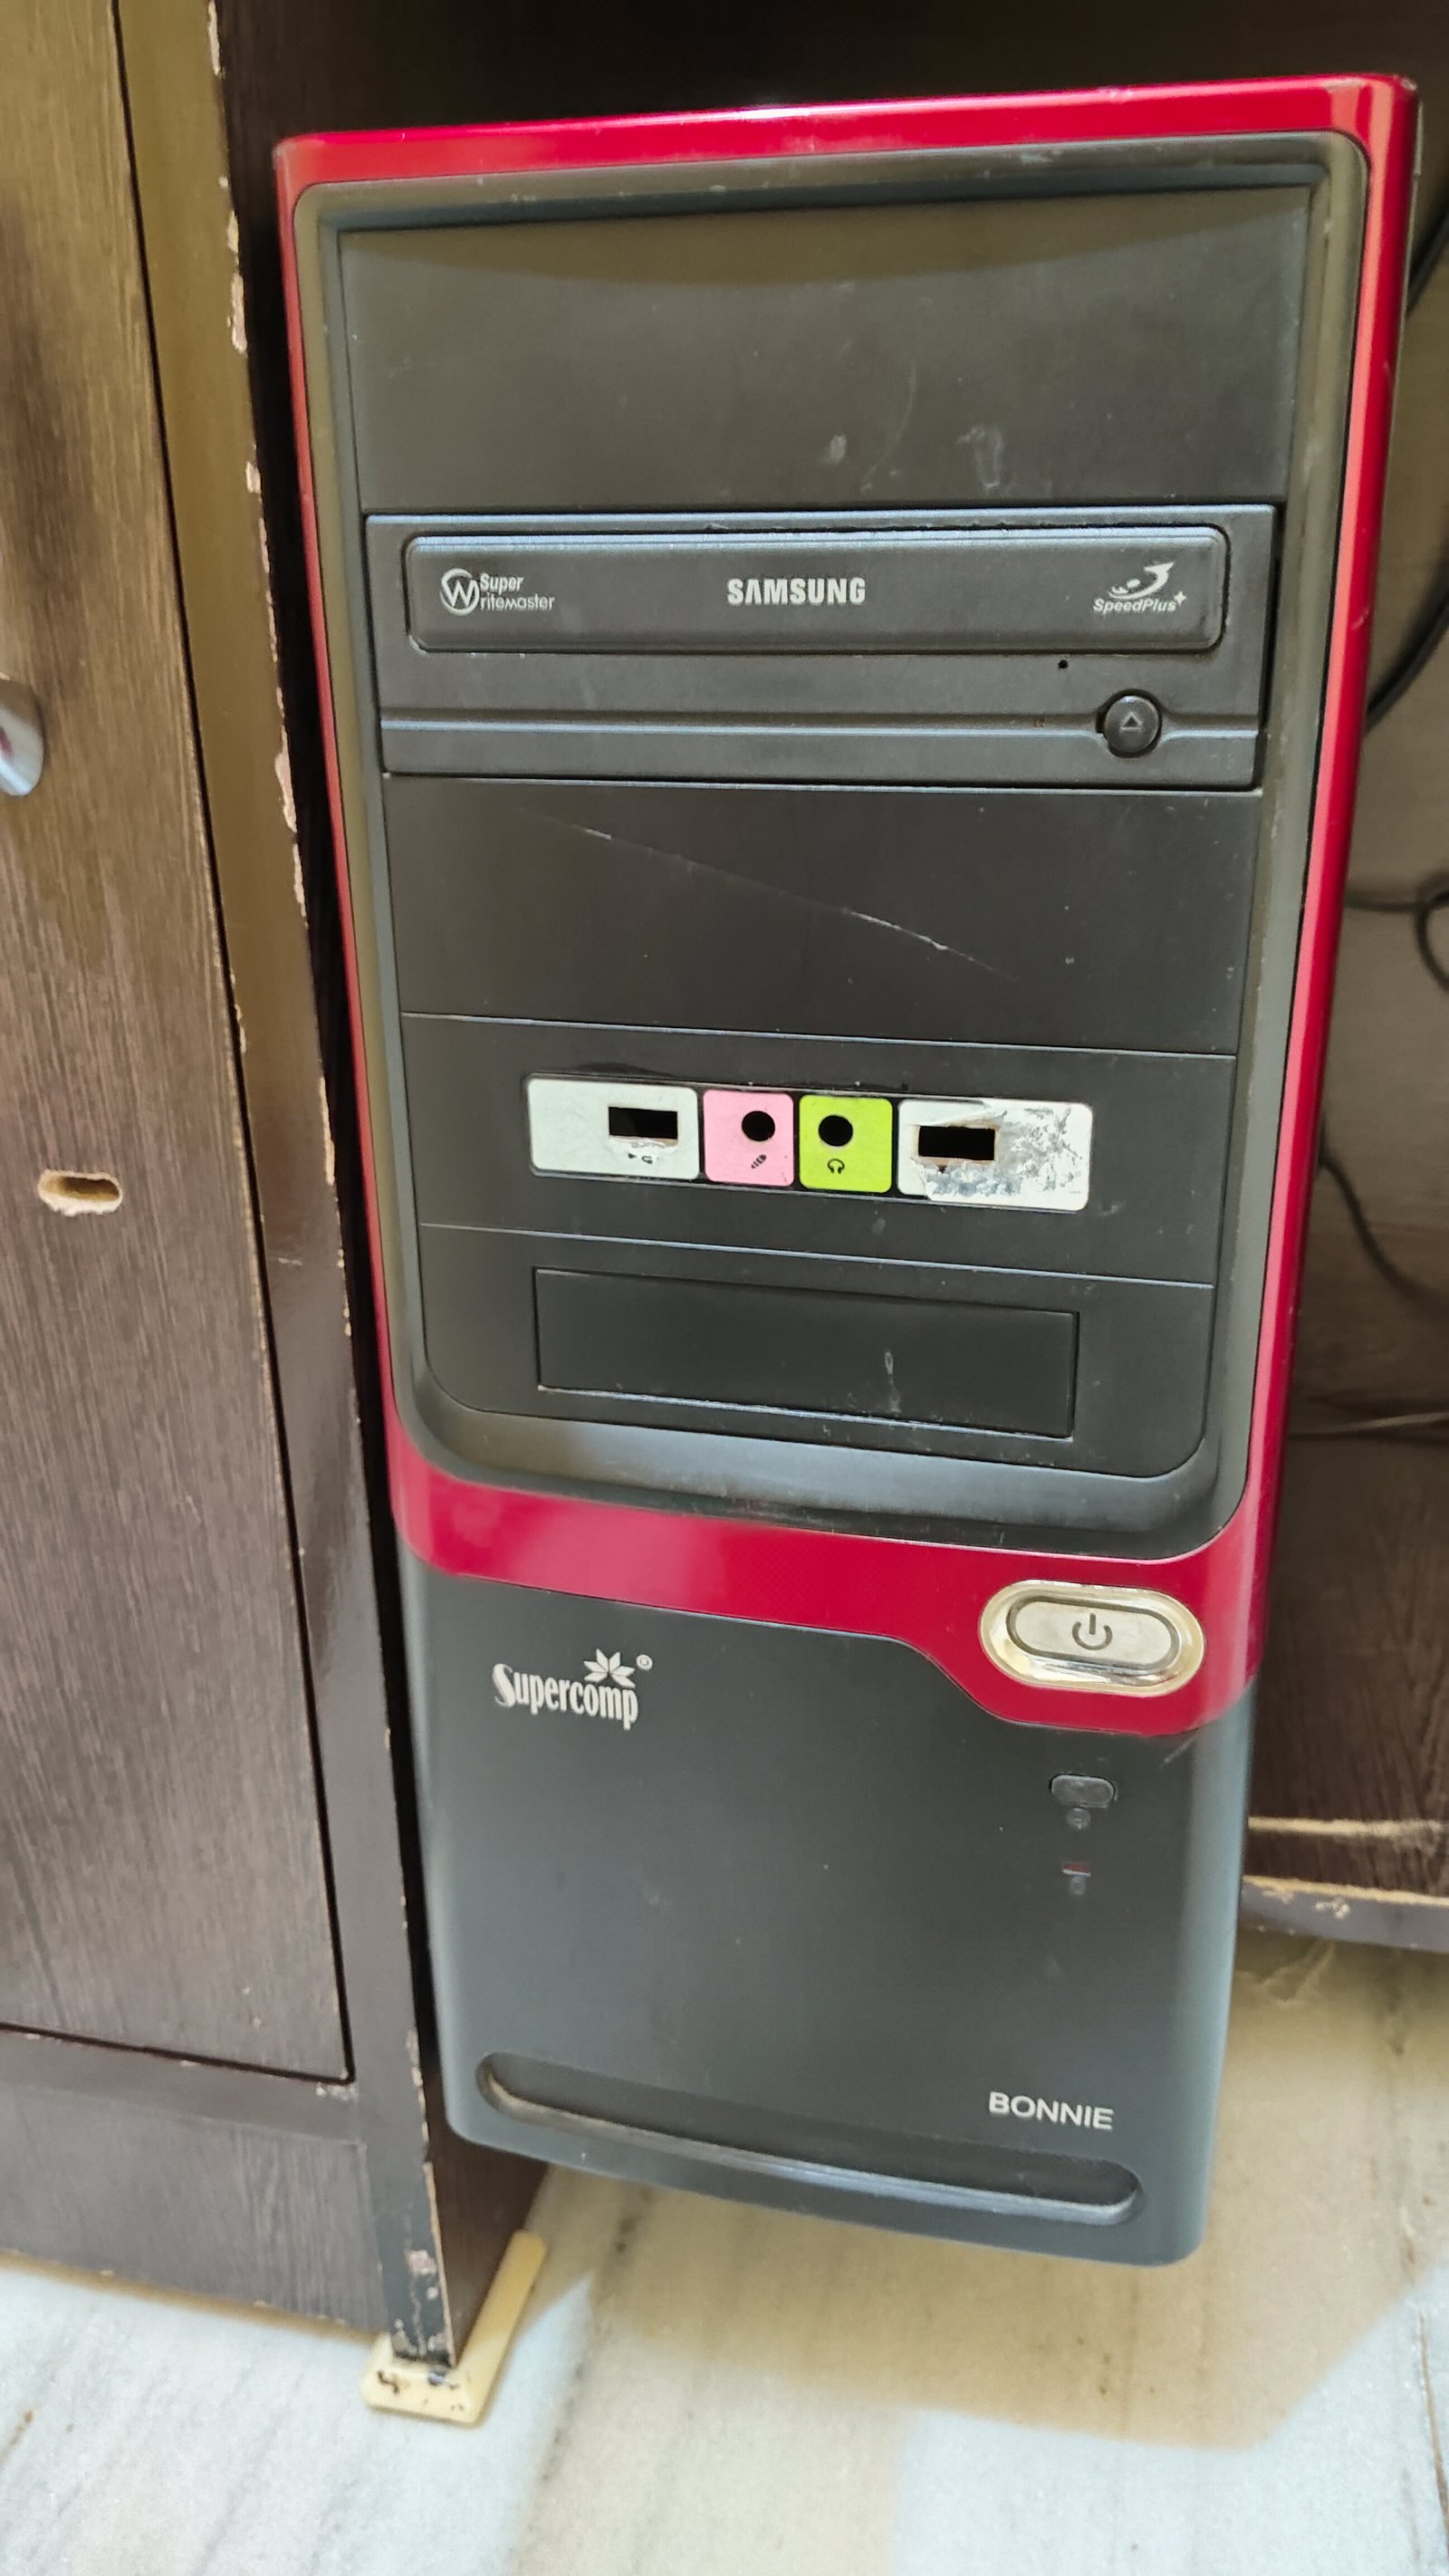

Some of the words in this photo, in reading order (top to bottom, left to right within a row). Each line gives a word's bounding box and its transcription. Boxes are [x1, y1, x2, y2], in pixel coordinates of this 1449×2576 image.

[479, 572, 523, 594] Super
[727, 577, 866, 605] SAMSUNG
[493, 1663, 638, 1730] Supercomp
[989, 2091, 1115, 2131] BONNIE
